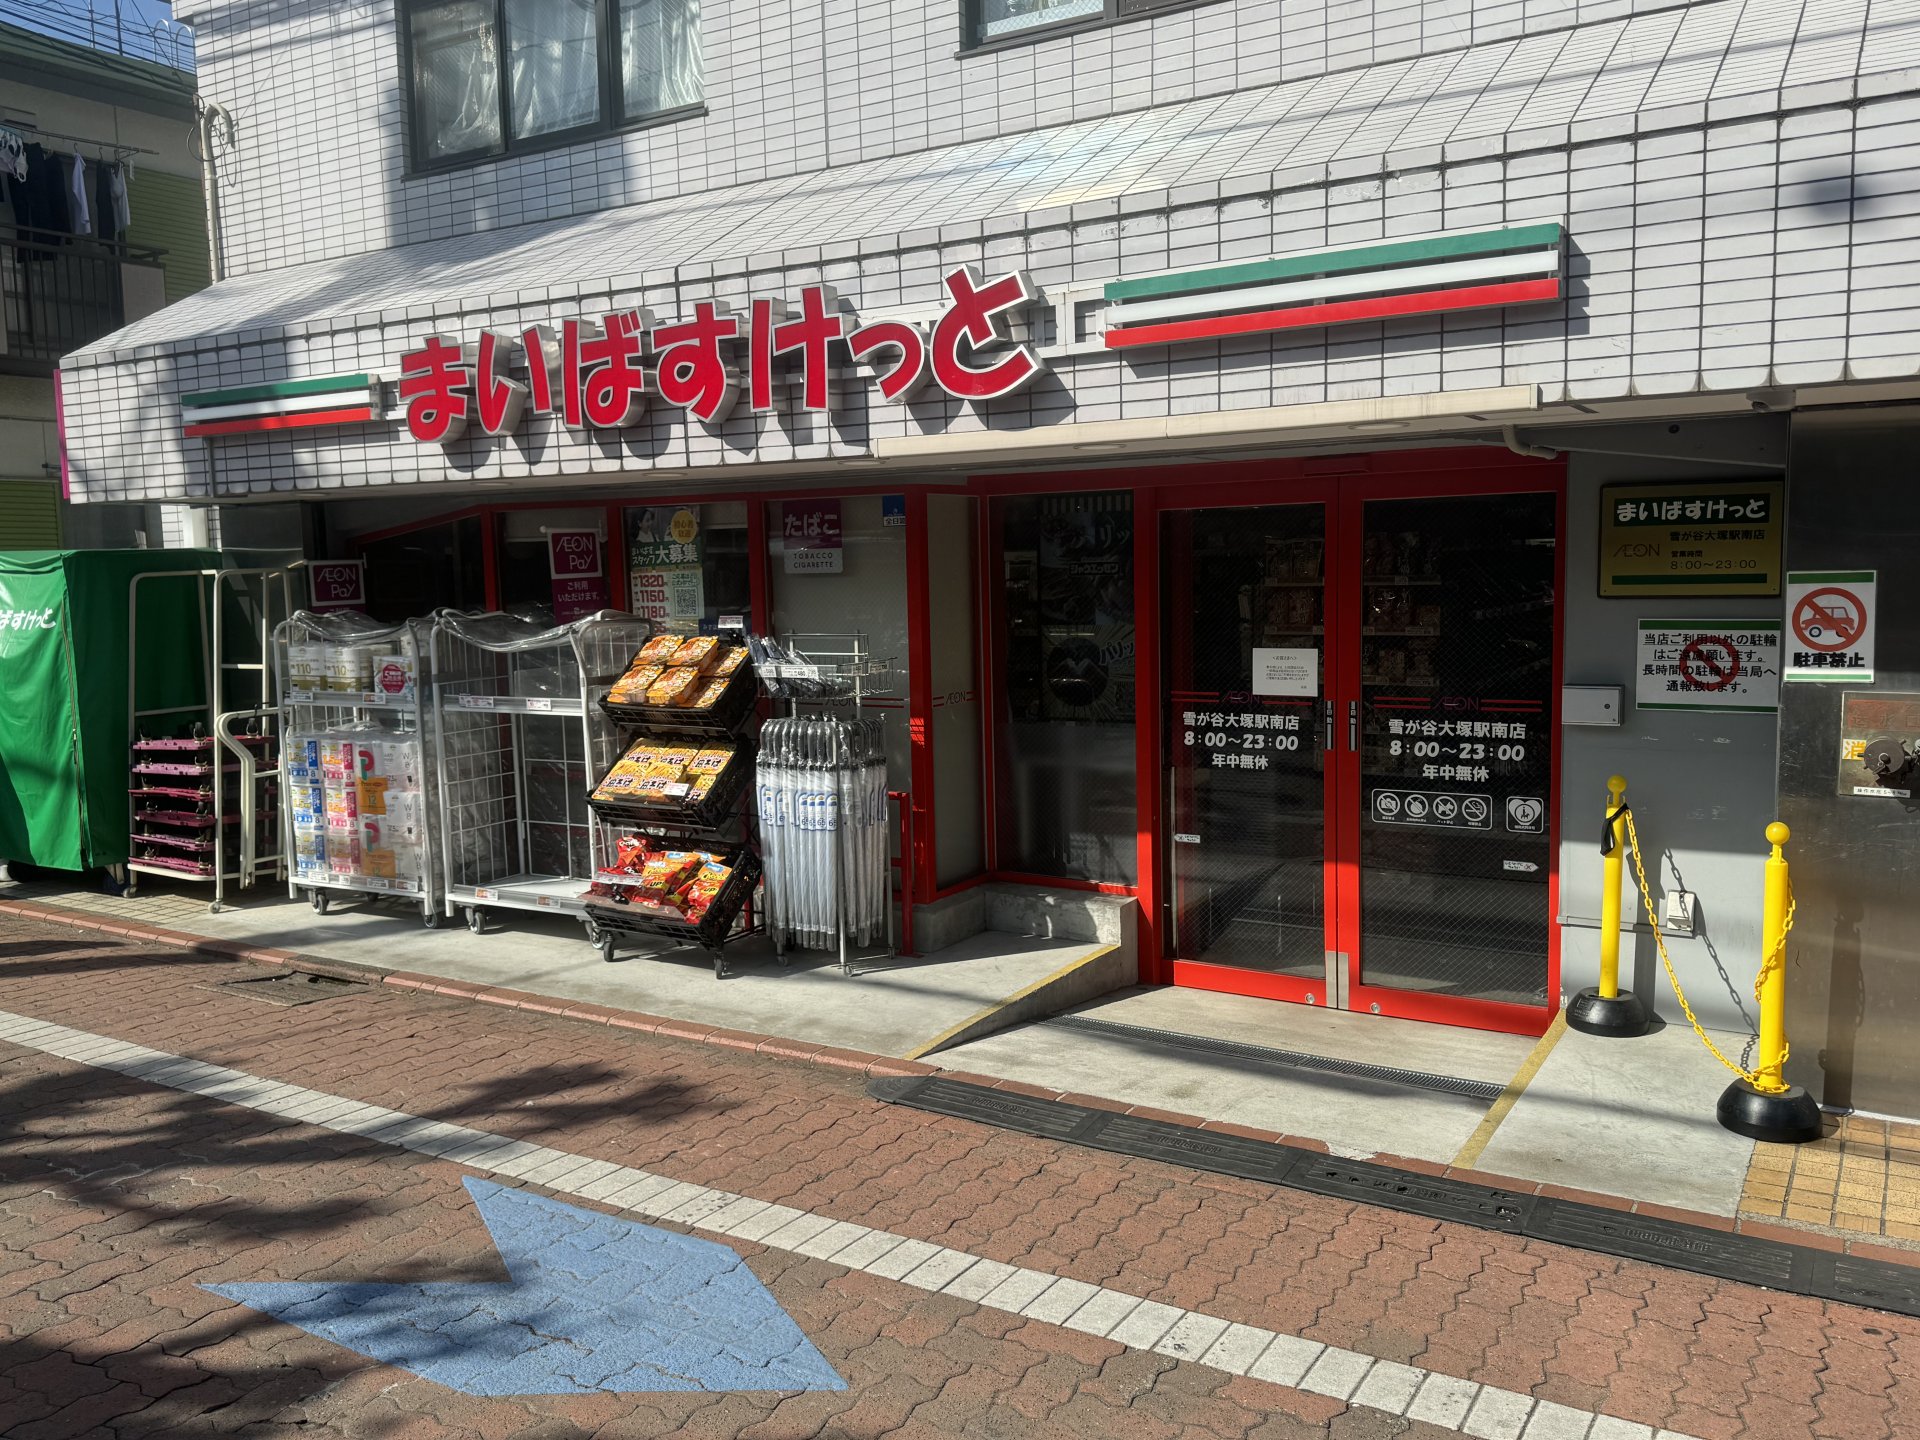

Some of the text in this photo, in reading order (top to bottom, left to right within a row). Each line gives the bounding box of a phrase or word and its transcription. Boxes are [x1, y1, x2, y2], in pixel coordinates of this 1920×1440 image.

[398, 263, 1042, 443] まいばすけっと
[1617, 498, 1766, 522] まいばすけっと
[784, 511, 840, 536] たばこ
[1670, 530, 1765, 541] 雪が谷大塚駅南店
[656, 543, 699, 564] 大募集
[1612, 544, 1660, 558] AEON
[1671, 550, 1703, 558] 営業時間
[567, 581, 589, 591] ご利用
[1644, 633, 1778, 646] 当店ご利用以外の駐輪
[1653, 649, 1763, 662] はご遠慮願います。
[1793, 651, 1865, 668] 駐車禁止
[1642, 664, 1778, 678] 長時間の駐輪は当局へ
[1666, 680, 1748, 694] 通報致します。
[1183, 711, 1300, 730] 雪が谷大塚駅南店
[1388, 719, 1527, 740] 雪が谷大塚駅南店
[1212, 753, 1269, 770] 年中無休
[1422, 763, 1490, 783] 年中無休
